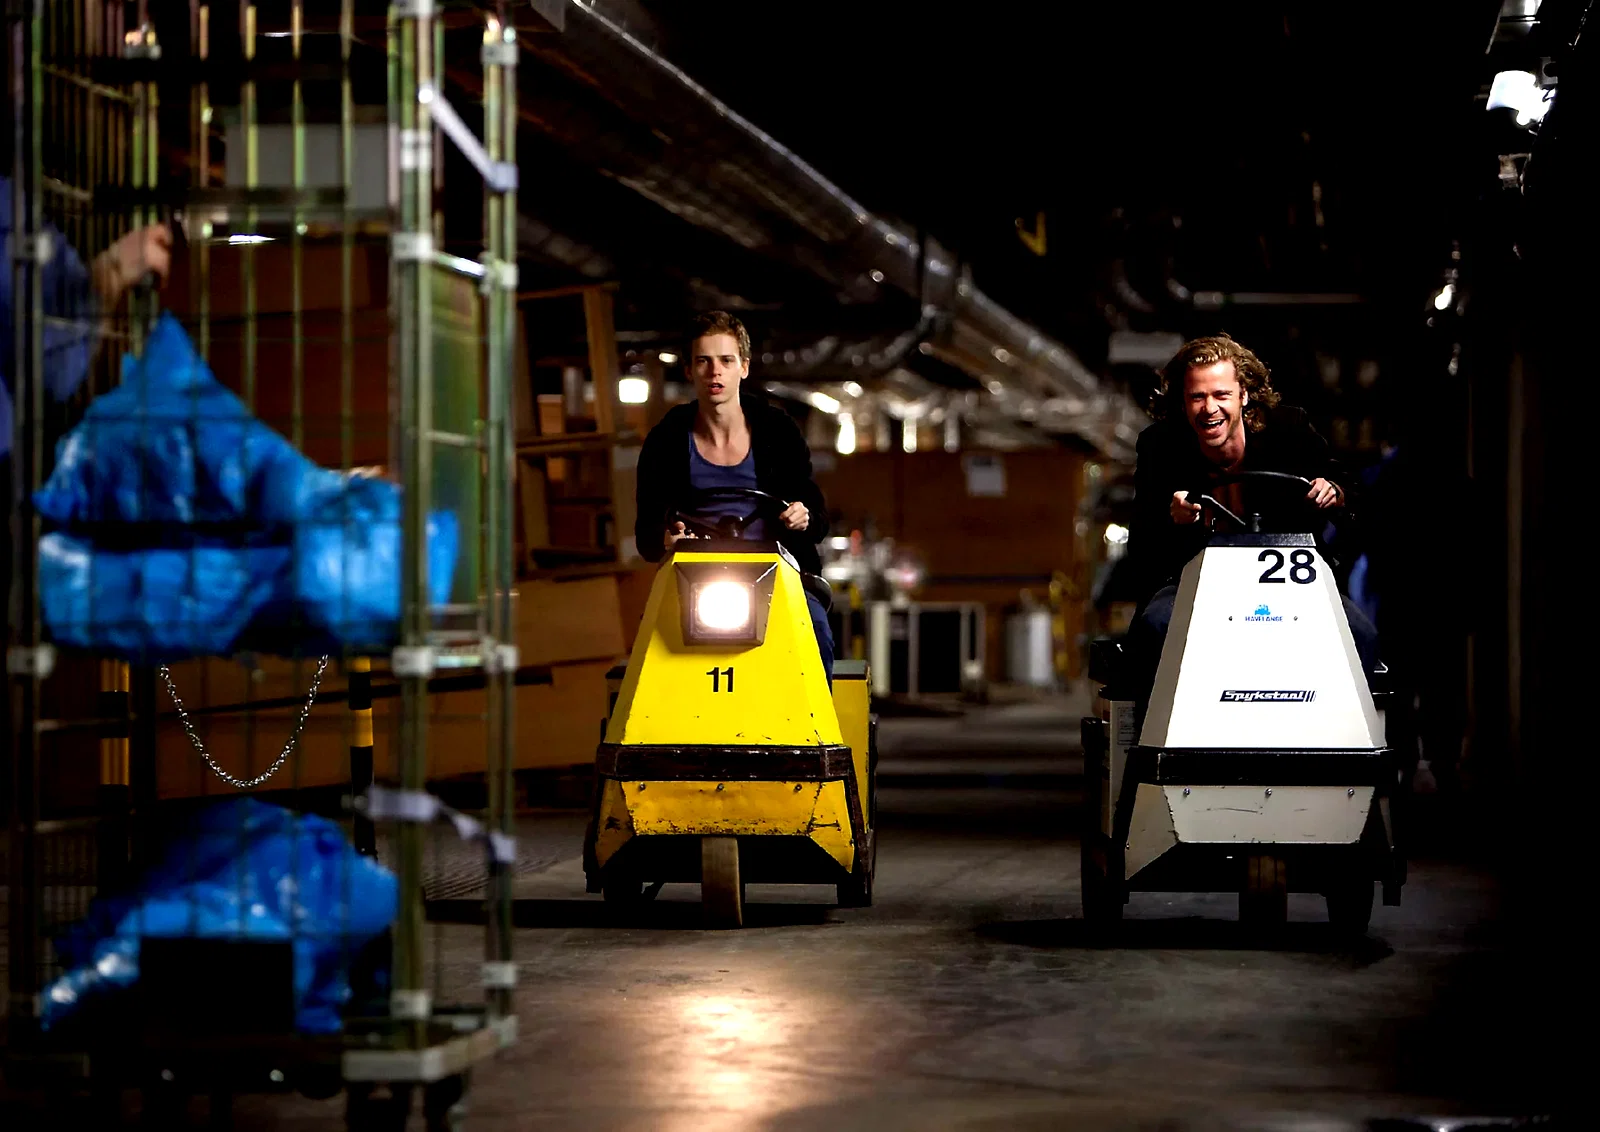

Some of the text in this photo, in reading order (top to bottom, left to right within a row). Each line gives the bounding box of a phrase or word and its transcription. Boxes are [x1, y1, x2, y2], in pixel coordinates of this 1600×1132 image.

[1258, 549, 1316, 584] 28
[706, 667, 734, 692] 11
[1223, 690, 1305, 702] Spykstaal
